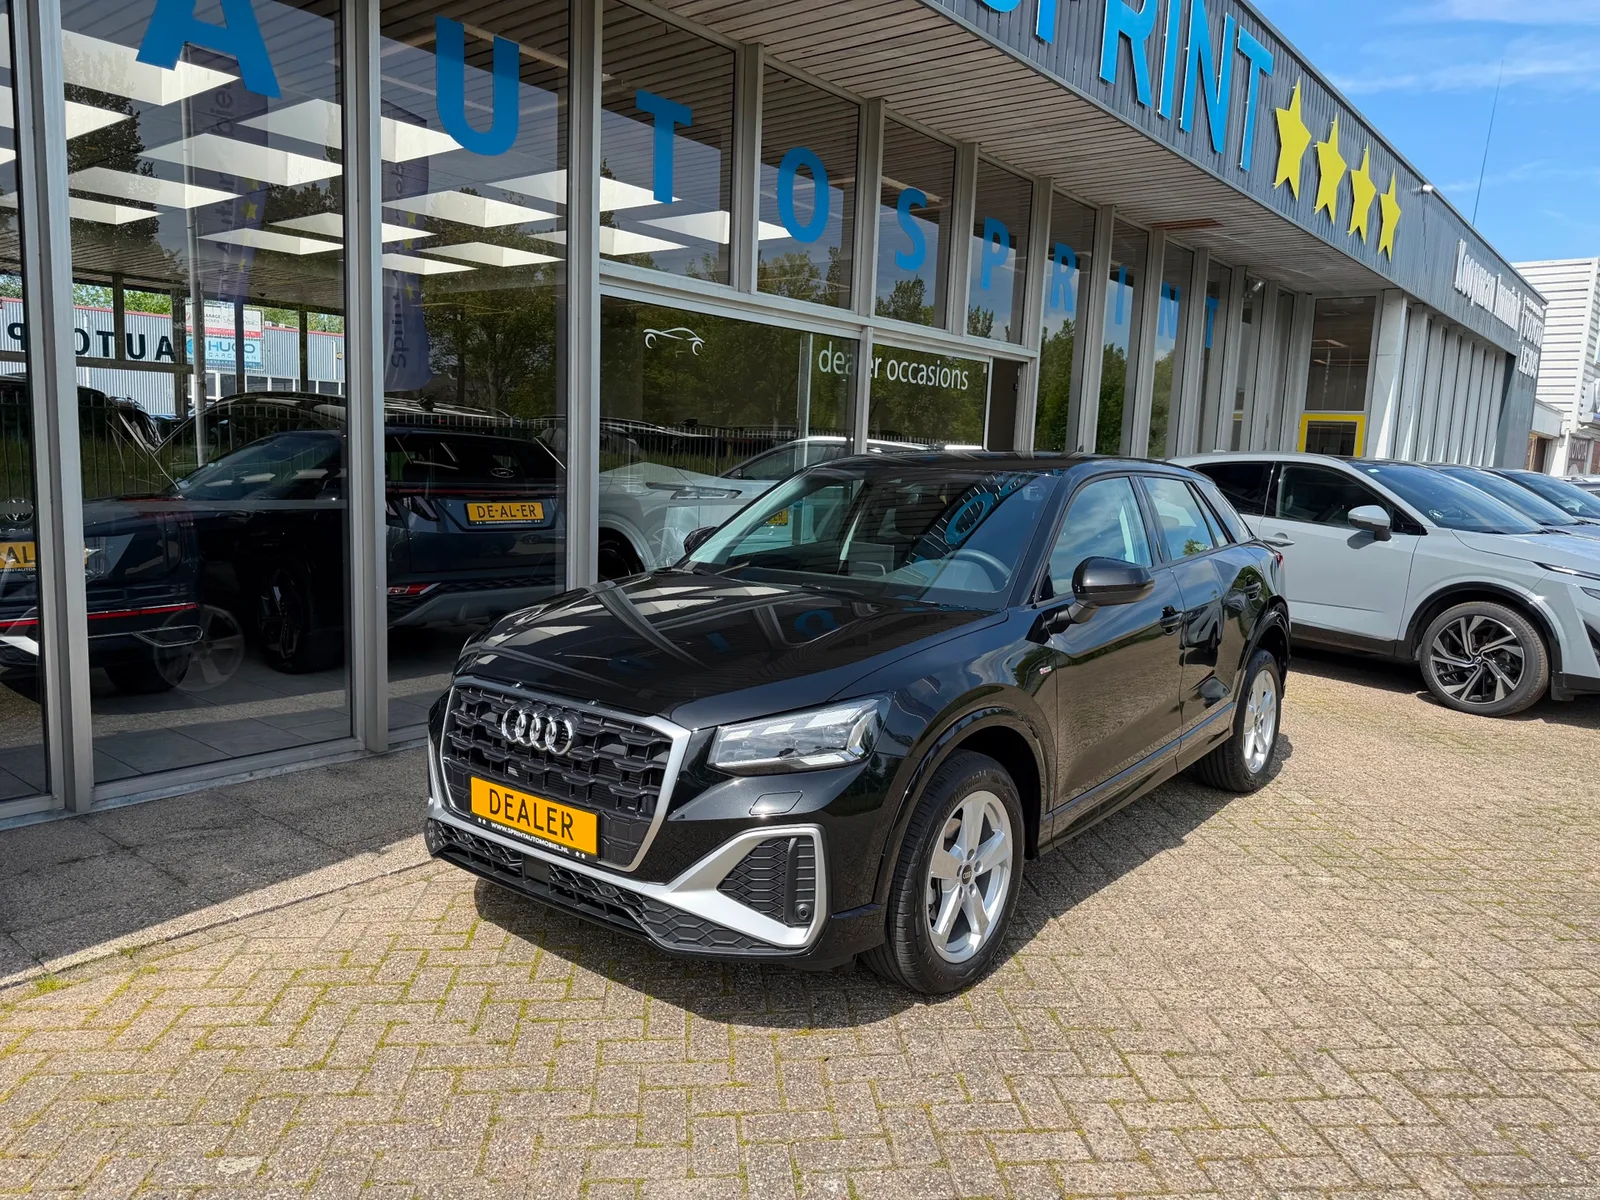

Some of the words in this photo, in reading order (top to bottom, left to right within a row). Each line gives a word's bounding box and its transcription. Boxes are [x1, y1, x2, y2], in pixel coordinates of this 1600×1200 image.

[976, 0, 1273, 172] RINT
[208, 340, 256, 354] HUO
[886, 359, 969, 390] occasions
[476, 505, 537, 519] DE-AL-ER
[489, 788, 575, 841] DEALER
